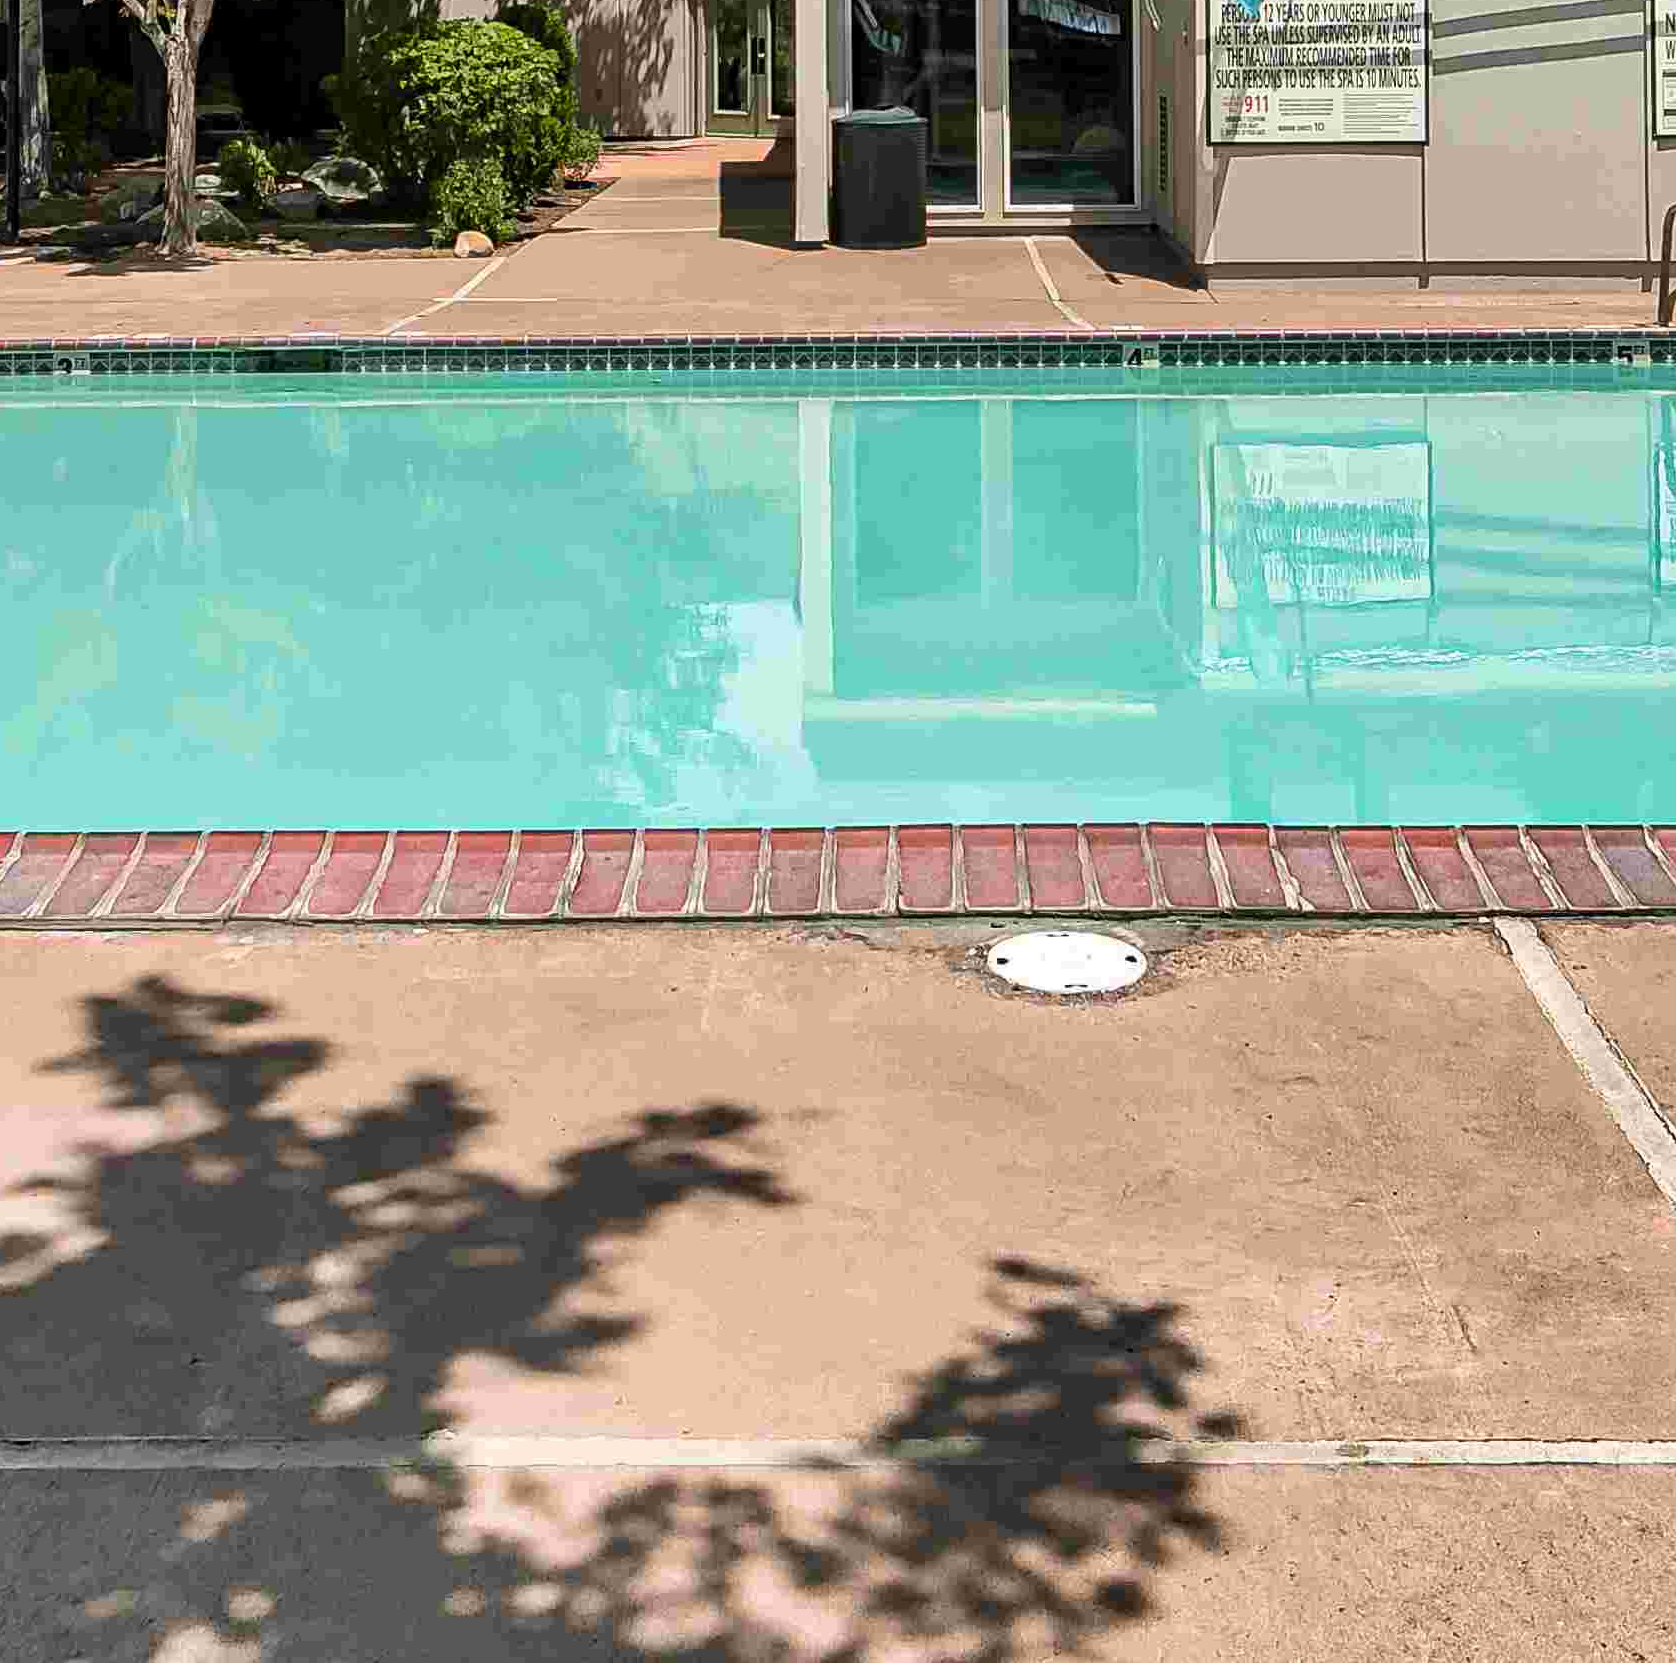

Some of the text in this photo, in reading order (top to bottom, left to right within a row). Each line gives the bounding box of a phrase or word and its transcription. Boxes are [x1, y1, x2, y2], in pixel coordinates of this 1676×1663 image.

[1264, 3, 1274, 23] 12
[1276, 3, 1305, 23] YEARS
[1308, 3, 1320, 23] OR
[1322, 3, 1366, 23] YOUNGER
[1368, 3, 1394, 23] MUST
[1396, 3, 1415, 23] NOT
[1214, 25, 1421, 45] USE THE SPA UNLESS SUPERVISED BY AN ADULT
[1227, 47, 1411, 67] THE MAXIMUM RECOMMENDED TIME FOR
[1216, 69, 1241, 89] SUCH
[1242, 69, 1283, 89] PERSONS
[1284, 69, 1297, 89] TO
[1299, 69, 1316, 89] USE
[1317, 68, 1335, 88] THE
[1337, 68, 1355, 88] SPA
[1356, 68, 1365, 88] IS
[1366, 68, 1377, 88] 10
[1244, 95, 1269, 113] 911
[1314, 122, 1324, 131] 10
[1127, 348, 1144, 366] 4
